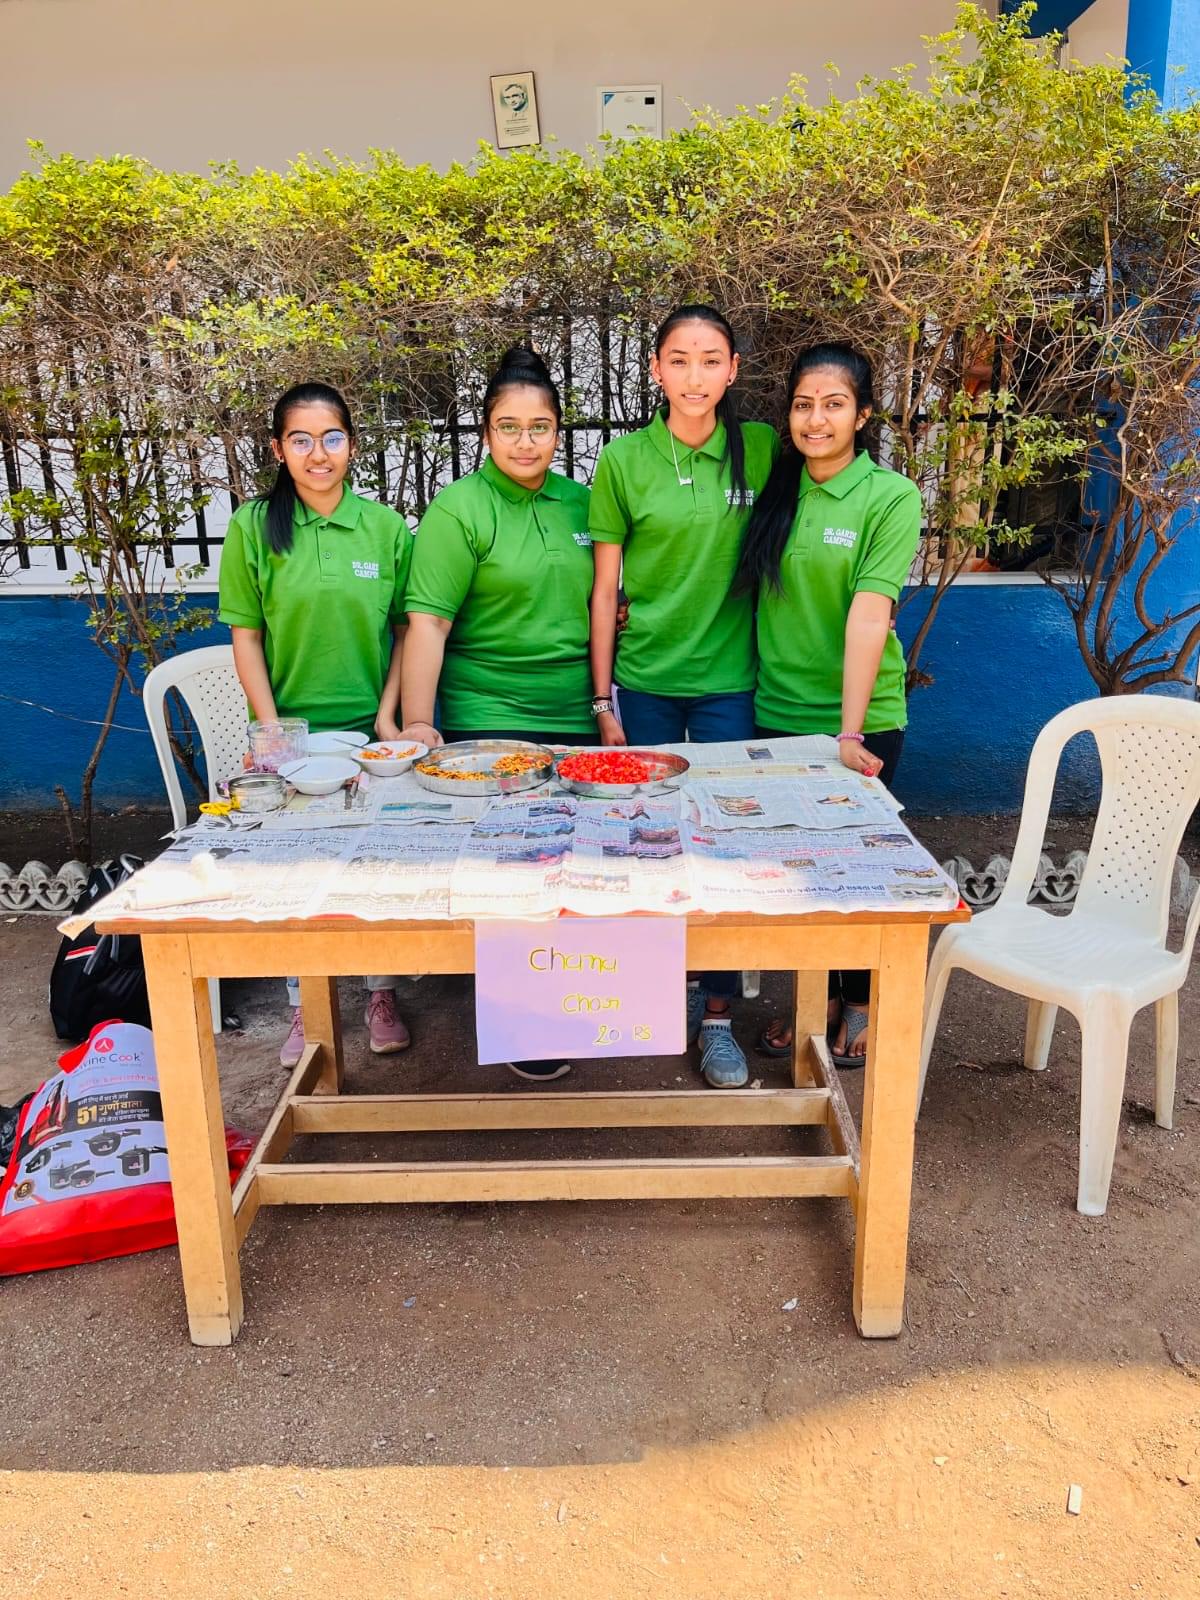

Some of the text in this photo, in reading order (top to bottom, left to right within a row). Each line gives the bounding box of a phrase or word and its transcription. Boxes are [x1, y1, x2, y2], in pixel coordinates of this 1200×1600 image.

[824, 536, 853, 548] CAMPUS
[595, 1025, 620, 1044] 20
[108, 1052, 141, 1062] Cook
[77, 1104, 98, 1125] 51
